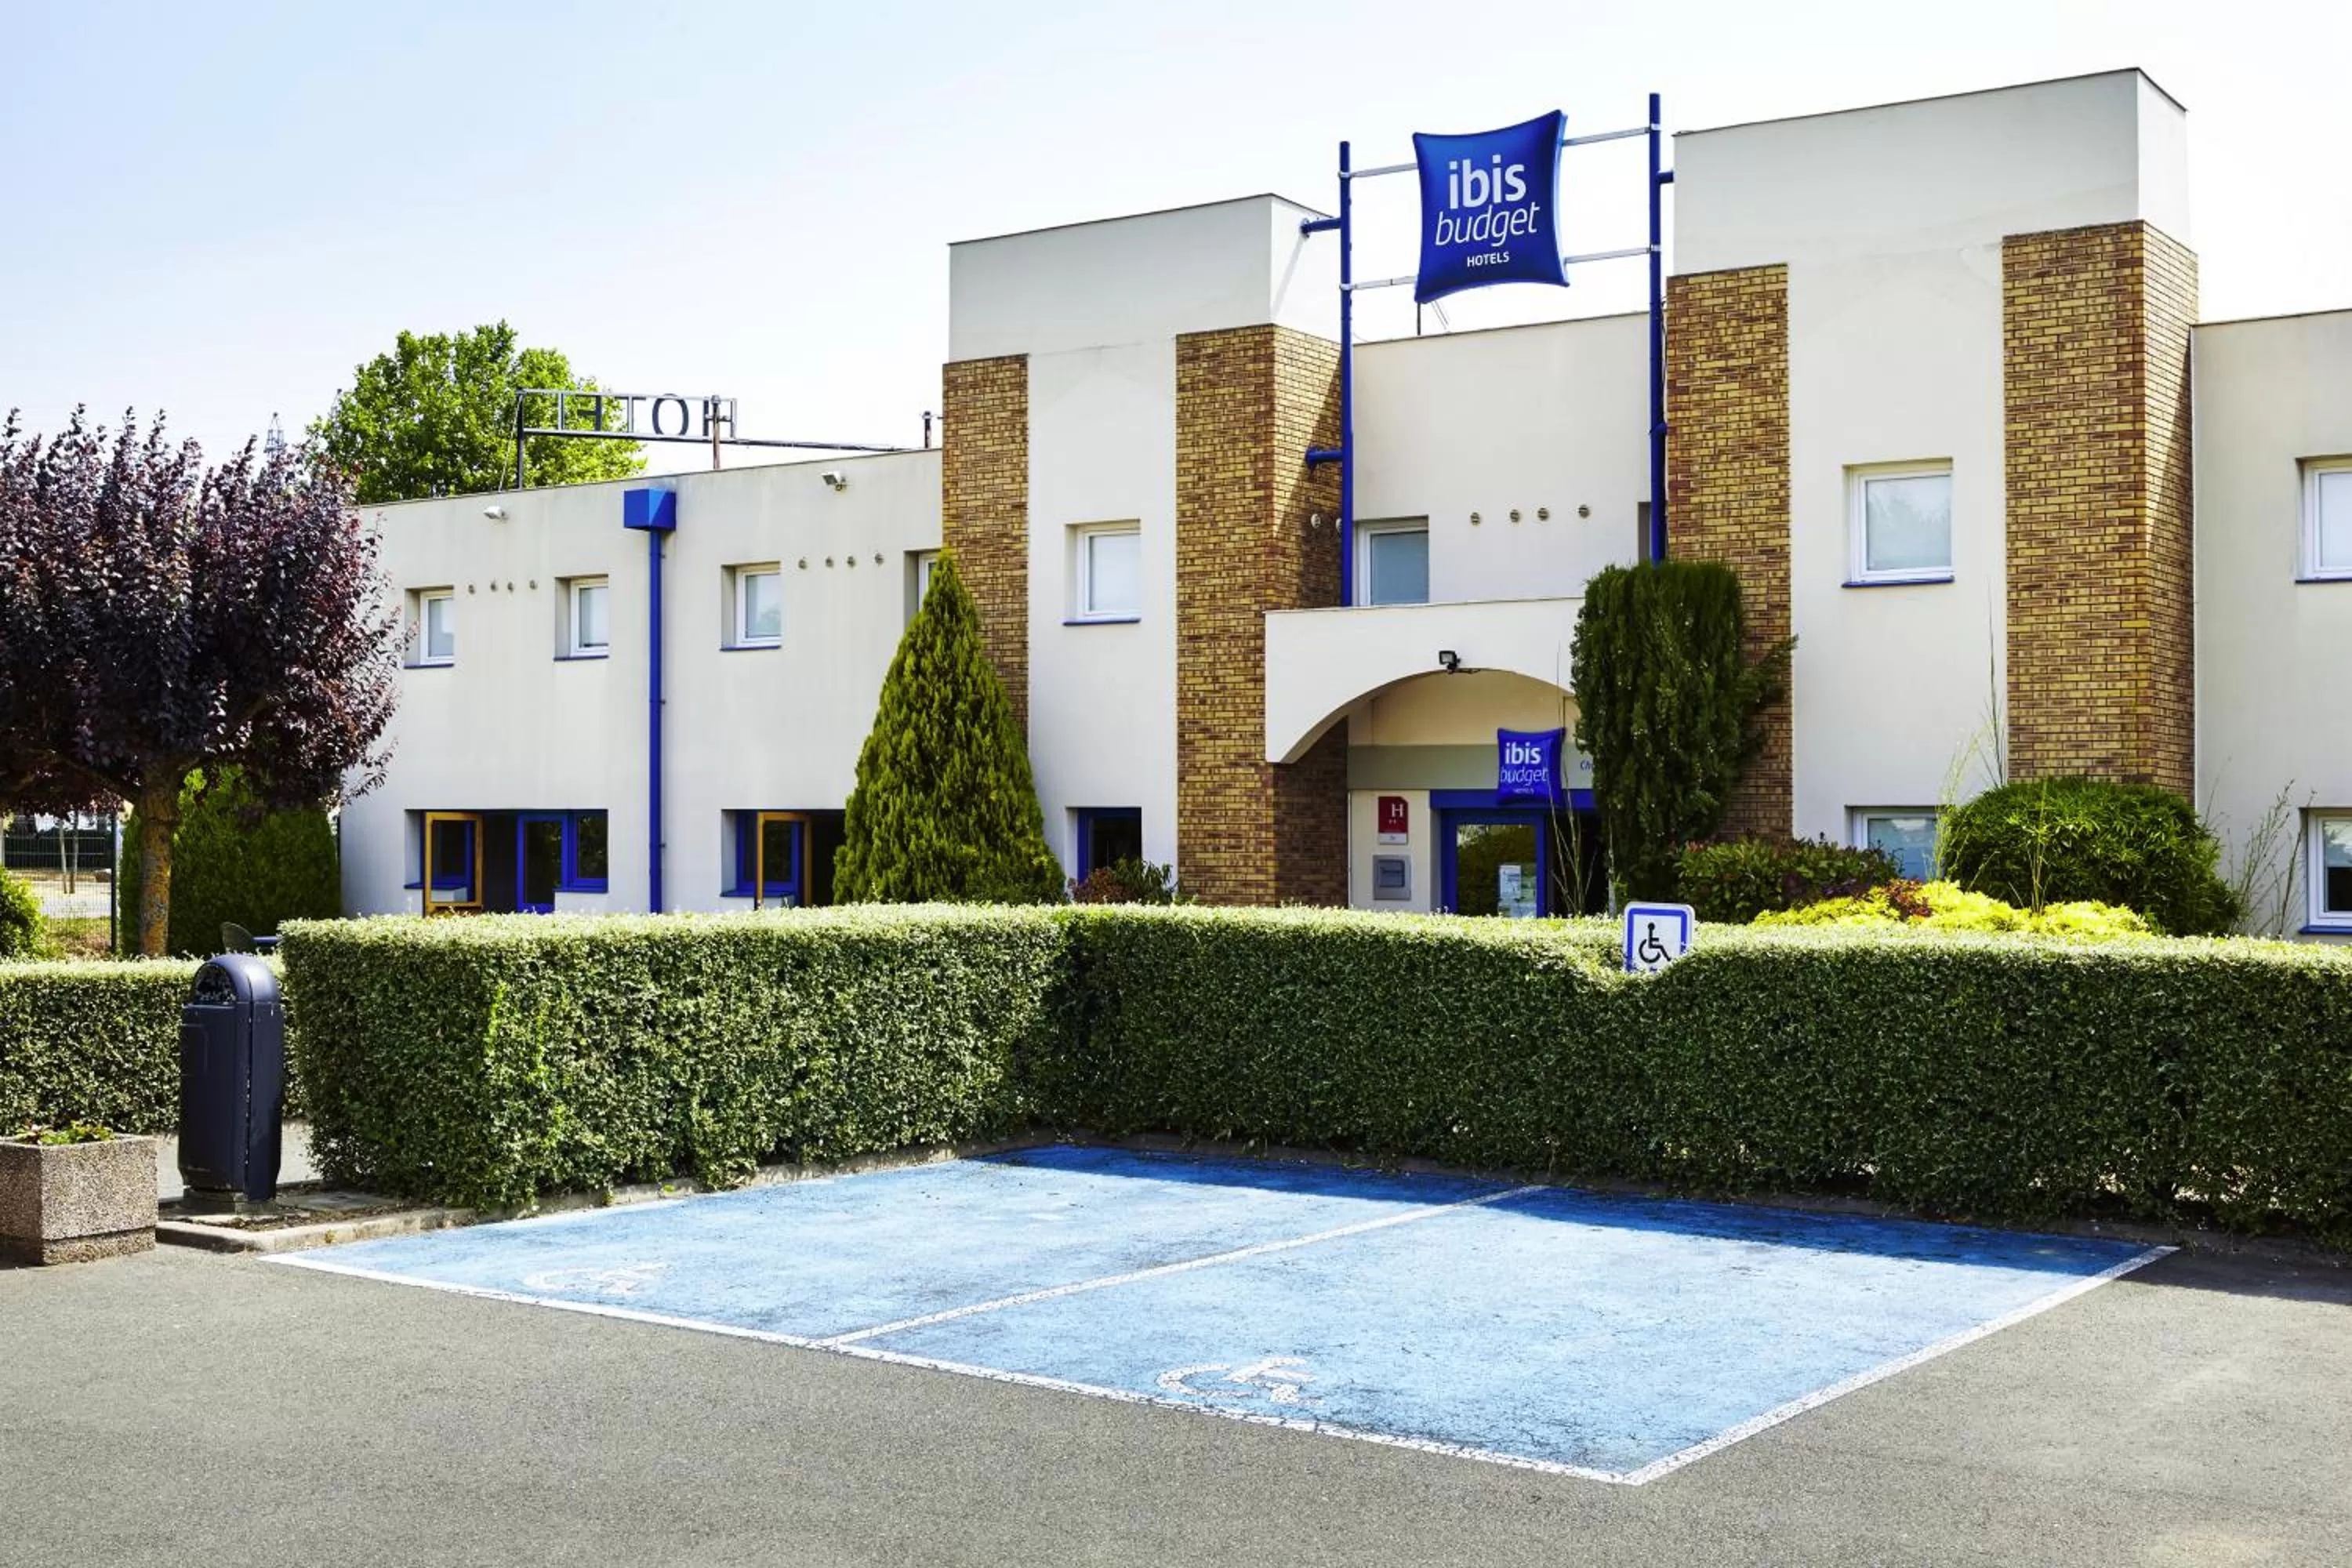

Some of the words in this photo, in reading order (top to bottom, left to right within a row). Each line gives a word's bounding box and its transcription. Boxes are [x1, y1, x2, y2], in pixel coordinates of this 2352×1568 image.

[1449, 154, 1526, 209] ibis
[1435, 202, 1540, 246] budget
[1467, 252, 1509, 267] HOTELS
[1504, 741, 1541, 764] ibis
[1500, 766, 1548, 786] budget
[1391, 803, 1405, 818] H
